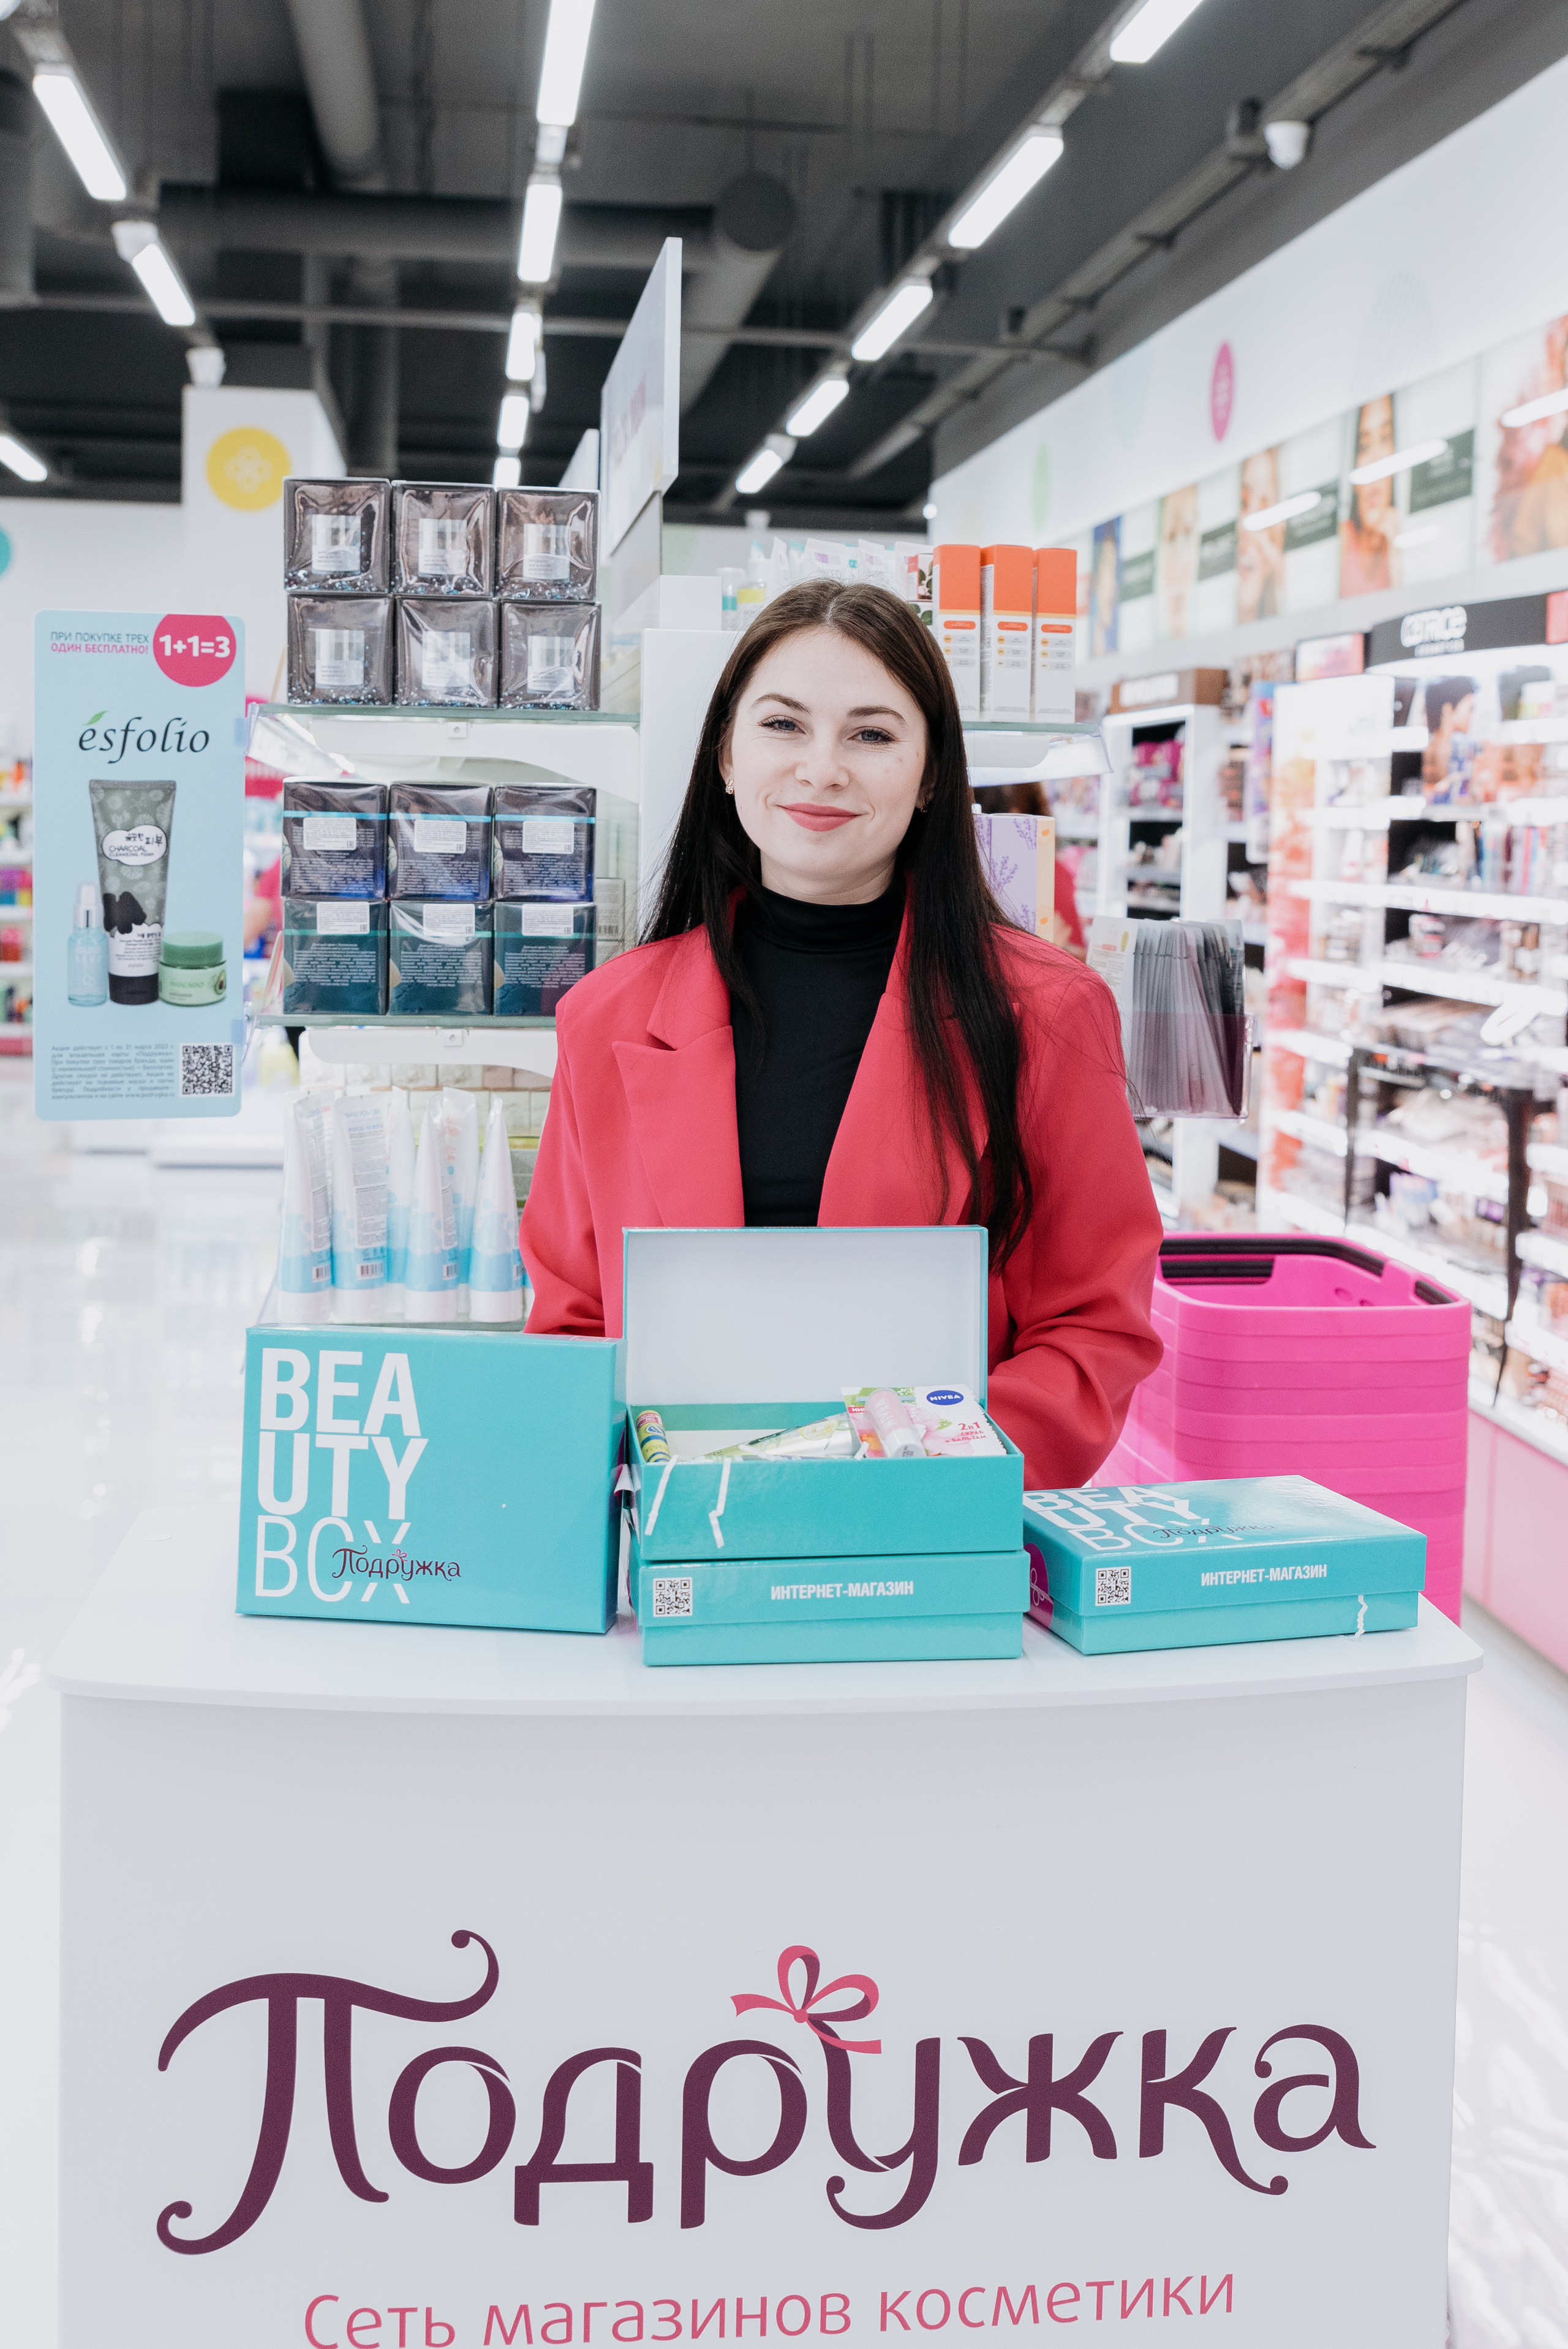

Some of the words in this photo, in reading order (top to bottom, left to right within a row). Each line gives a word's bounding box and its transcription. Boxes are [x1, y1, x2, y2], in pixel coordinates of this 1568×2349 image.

[51, 632, 72, 641] ПРИ
[75, 632, 122, 643] ПОКУПКЕ
[126, 633, 149, 643] ТРЕХ
[51, 643, 81, 653] ОДИН
[85, 643, 149, 654] БЕСПЛАТНО!
[159, 635, 231, 658] 1+1=3
[260, 1348, 422, 1437] BEA
[258, 1431, 429, 1520] UTY
[1023, 1486, 1180, 1511] BEA
[1039, 1499, 1202, 1529] UTY
[1153, 1524, 1276, 1540] Подружка
[331, 1545, 462, 1581] Подружка
[1201, 1564, 1328, 1587] ИНТЕРНЕТ-МАГАЗИН
[771, 1580, 914, 1600] ИНТЕРНЕТ-МАГАЗИН
[157, 1929, 1376, 2255] Подружка
[305, 2294, 456, 2349] Сеть
[483, 2293, 851, 2345] магазинов
[880, 2274, 1233, 2331] косметики
